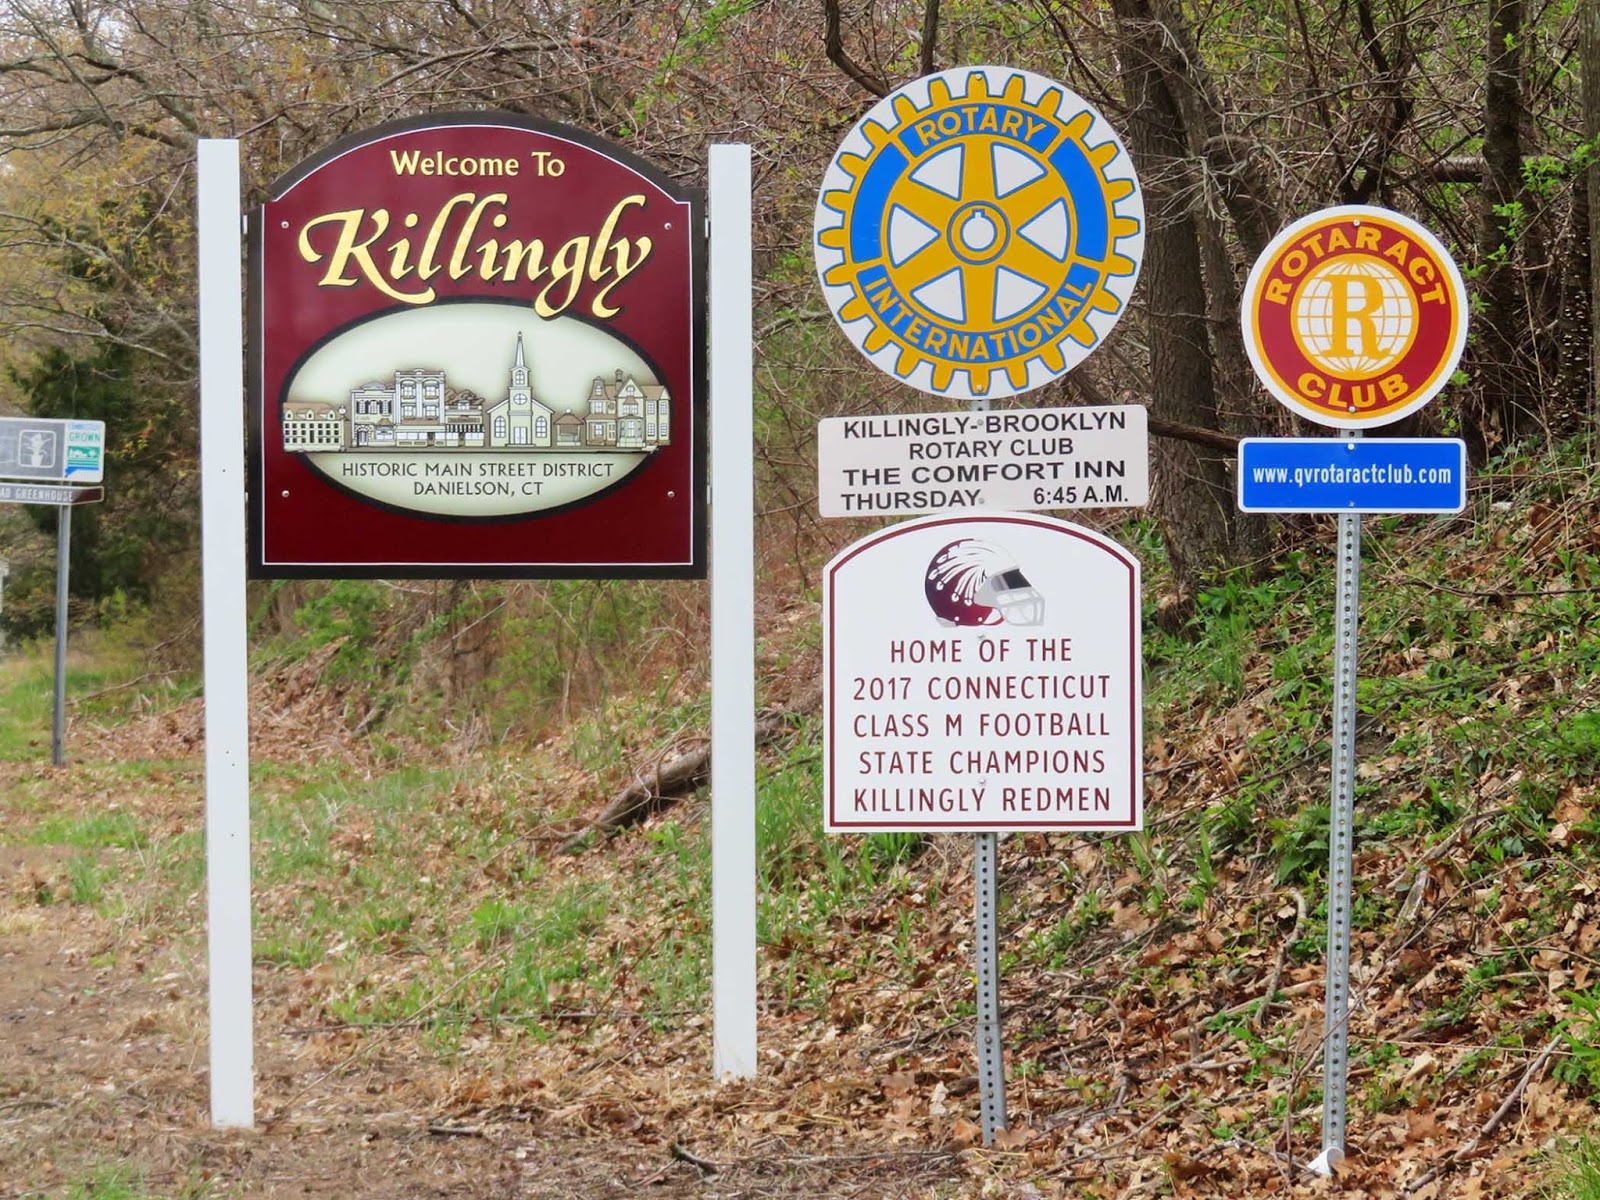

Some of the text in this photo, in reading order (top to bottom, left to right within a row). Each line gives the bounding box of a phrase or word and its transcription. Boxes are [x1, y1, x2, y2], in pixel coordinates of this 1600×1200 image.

[914, 106, 1047, 147] ROTARY
[390, 150, 566, 178] Welcome To
[299, 192, 653, 319] Killingly
[1265, 226, 1446, 305] ROTARACT
[864, 276, 1093, 360] INTERNATIONAL
[1321, 274, 1391, 360] R
[1297, 372, 1409, 408] CLUB
[909, 438, 1074, 460] ROTARY CLUB
[342, 462, 614, 477] HISTORIC MAIN STREET DISTRICT
[843, 460, 1126, 486] THE COMFORT INN
[1253, 463, 1451, 487] www.qvrotaractclub.com
[15, 489, 73, 502] GREENHOUSE
[414, 481, 544, 497] DANIELSON, CT
[841, 484, 1129, 511] THURSDAY 6:45 A.M.
[891, 638, 1072, 663] HOME OF THE
[854, 675, 1110, 700] 2017 CONNECTICUT
[854, 713, 1110, 738] CLASS M FOOTBALL
[859, 749, 1105, 775] STATE CHAMPIONS
[854, 787, 1110, 812] KILLINGLY REDMEN
